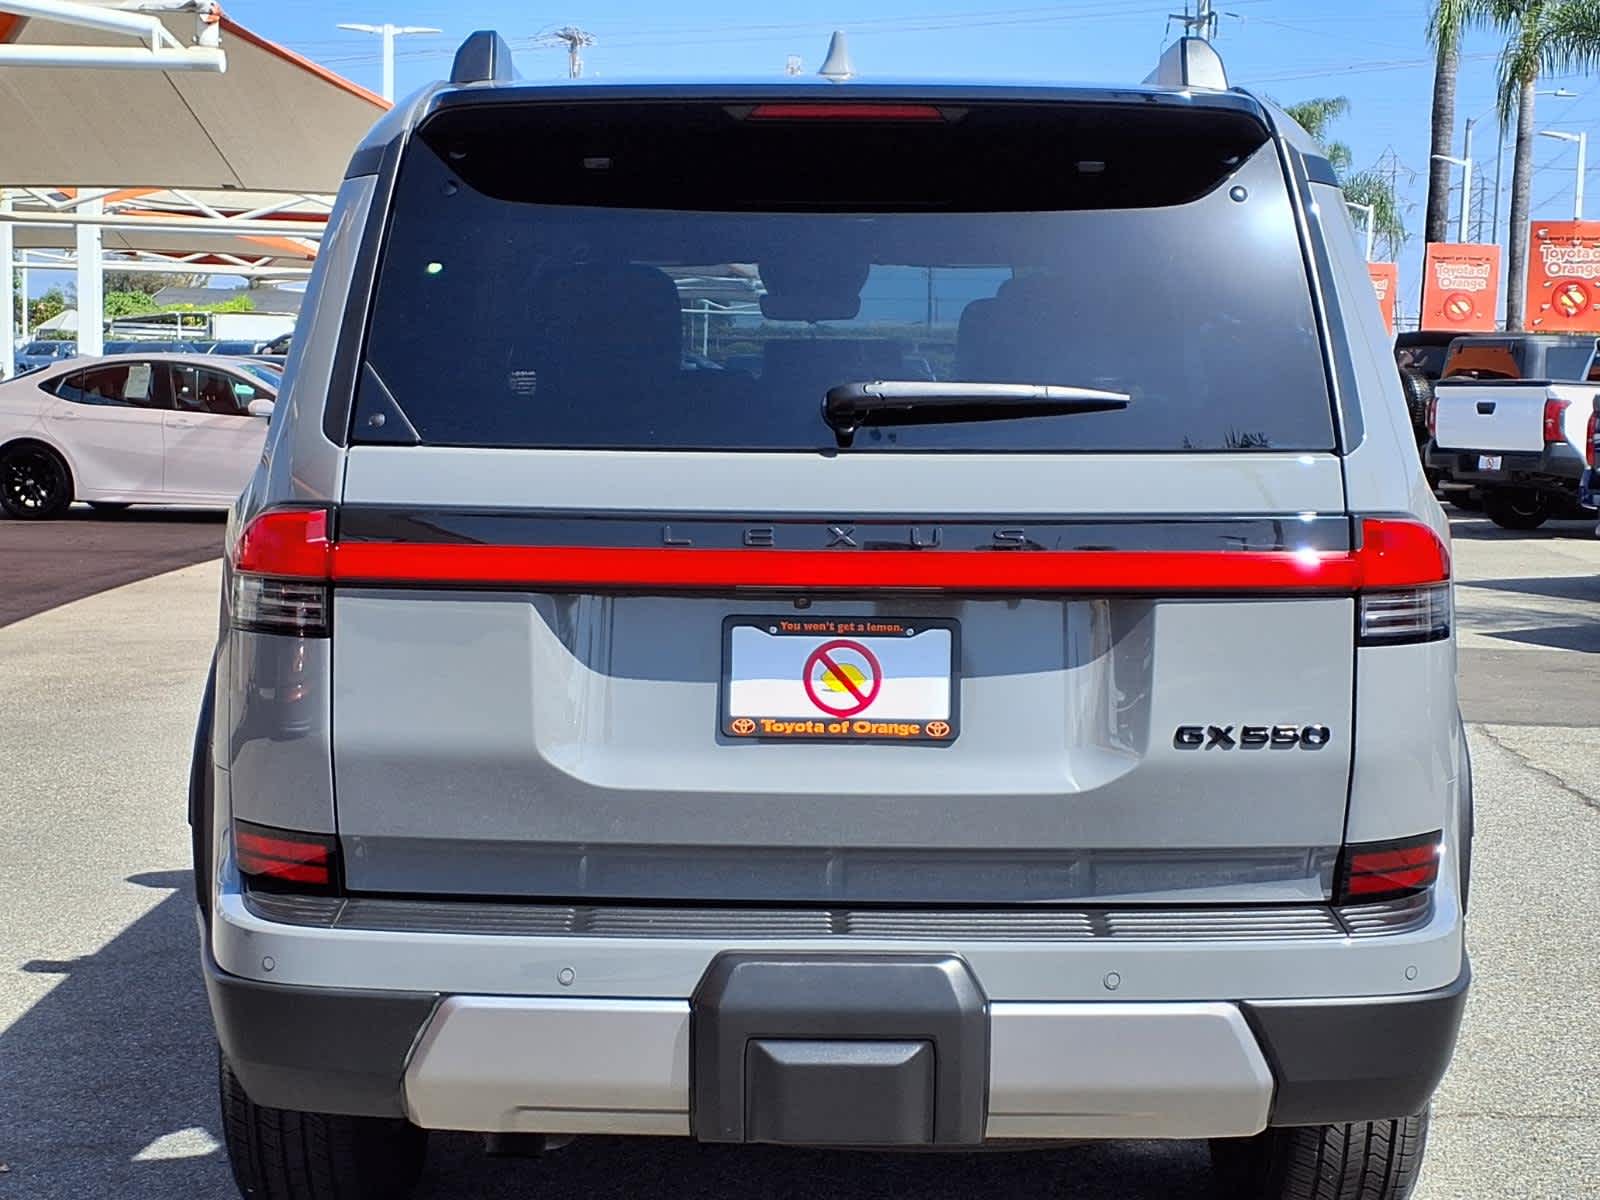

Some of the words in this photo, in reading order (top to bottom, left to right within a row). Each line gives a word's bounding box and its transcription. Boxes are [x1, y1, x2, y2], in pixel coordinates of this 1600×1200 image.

[1542, 245, 1590, 260] Toyota
[1436, 263, 1475, 277] Toyota
[1476, 264, 1490, 276] of
[1440, 278, 1485, 290] Orange
[662, 524, 1025, 548] LEXUS
[780, 621, 801, 631] You
[803, 621, 835, 632] won't
[837, 622, 855, 634] get
[857, 624, 865, 632] a
[867, 622, 904, 632] lemon.
[760, 718, 825, 735] Toyota
[828, 720, 850, 735] of
[853, 720, 920, 736] Orange
